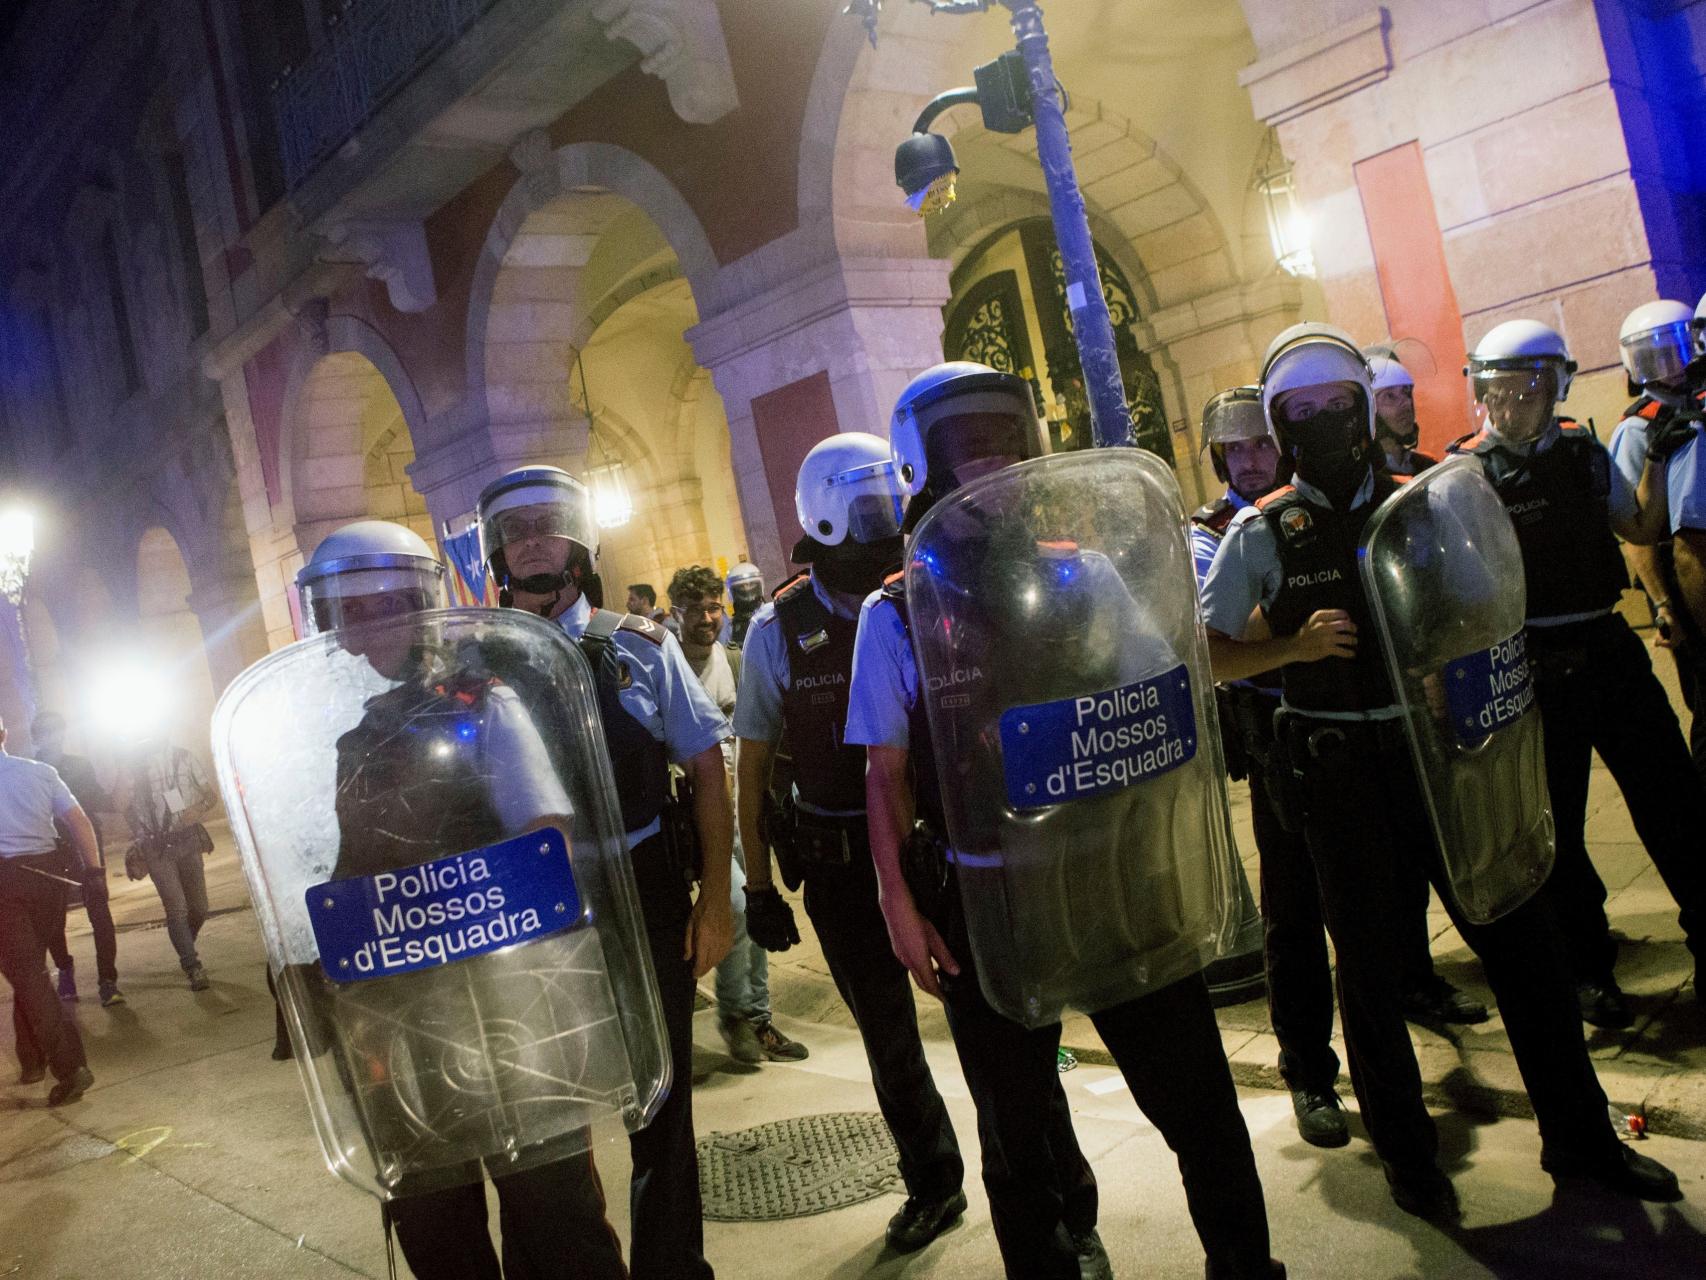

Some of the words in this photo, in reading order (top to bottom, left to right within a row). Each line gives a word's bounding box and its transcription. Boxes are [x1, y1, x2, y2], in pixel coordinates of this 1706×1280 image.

[1287, 568, 1342, 589] POLICIA
[795, 673, 846, 690] POLICIA
[927, 666, 983, 691] OLICIA
[1075, 684, 1160, 726] Policia
[1071, 714, 1167, 759] Mossos
[1046, 738, 1184, 796] d'Esquadra
[374, 857, 491, 903] Policia
[372, 886, 506, 936] Mossos
[354, 907, 542, 972] d'Esquadra
